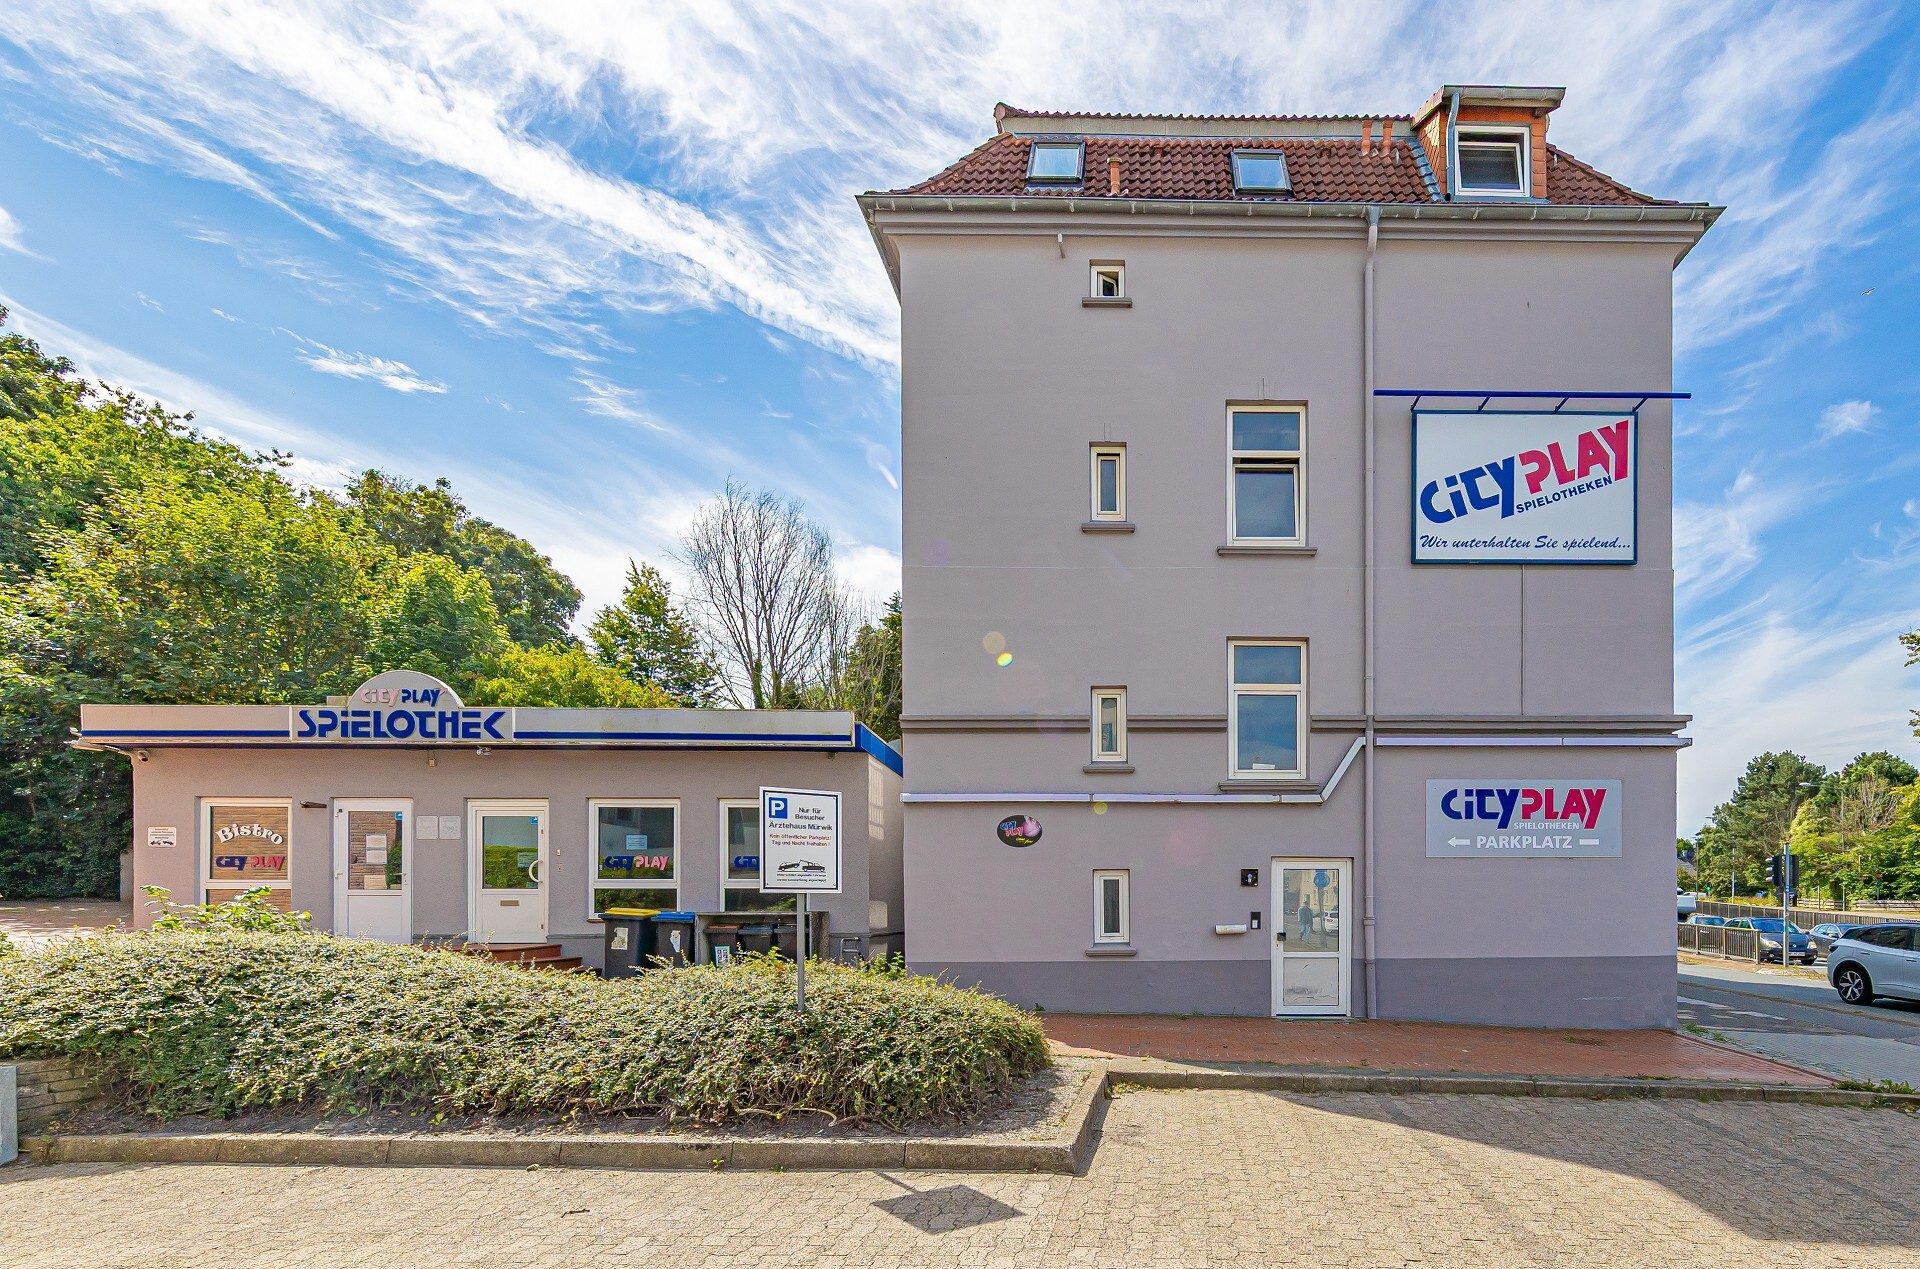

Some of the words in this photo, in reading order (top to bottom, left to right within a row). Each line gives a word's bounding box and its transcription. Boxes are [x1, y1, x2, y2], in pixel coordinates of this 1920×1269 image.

[1518, 419, 1630, 495] PLAY
[1515, 474, 1613, 514] SPIELOTHEKEN
[1419, 534, 1449, 548] Wir
[1451, 535, 1531, 549] unterhalten
[1534, 535, 1558, 549] Sie
[1562, 536, 1631, 551] spielend...
[401, 687, 445, 707] PLAY
[771, 800, 785, 816] P
[1521, 788, 1607, 830] PLAY
[794, 813, 825, 821] Besucher
[215, 823, 284, 845] Bistro
[768, 821, 807, 830] Ärztehaus
[808, 823, 833, 831] Mürwik
[1513, 822, 1580, 830] SPIELOTHEKEN
[1476, 835, 1573, 849] PARKPLATZ
[250, 855, 286, 871] PLAY
[634, 855, 669, 871] PLAY
